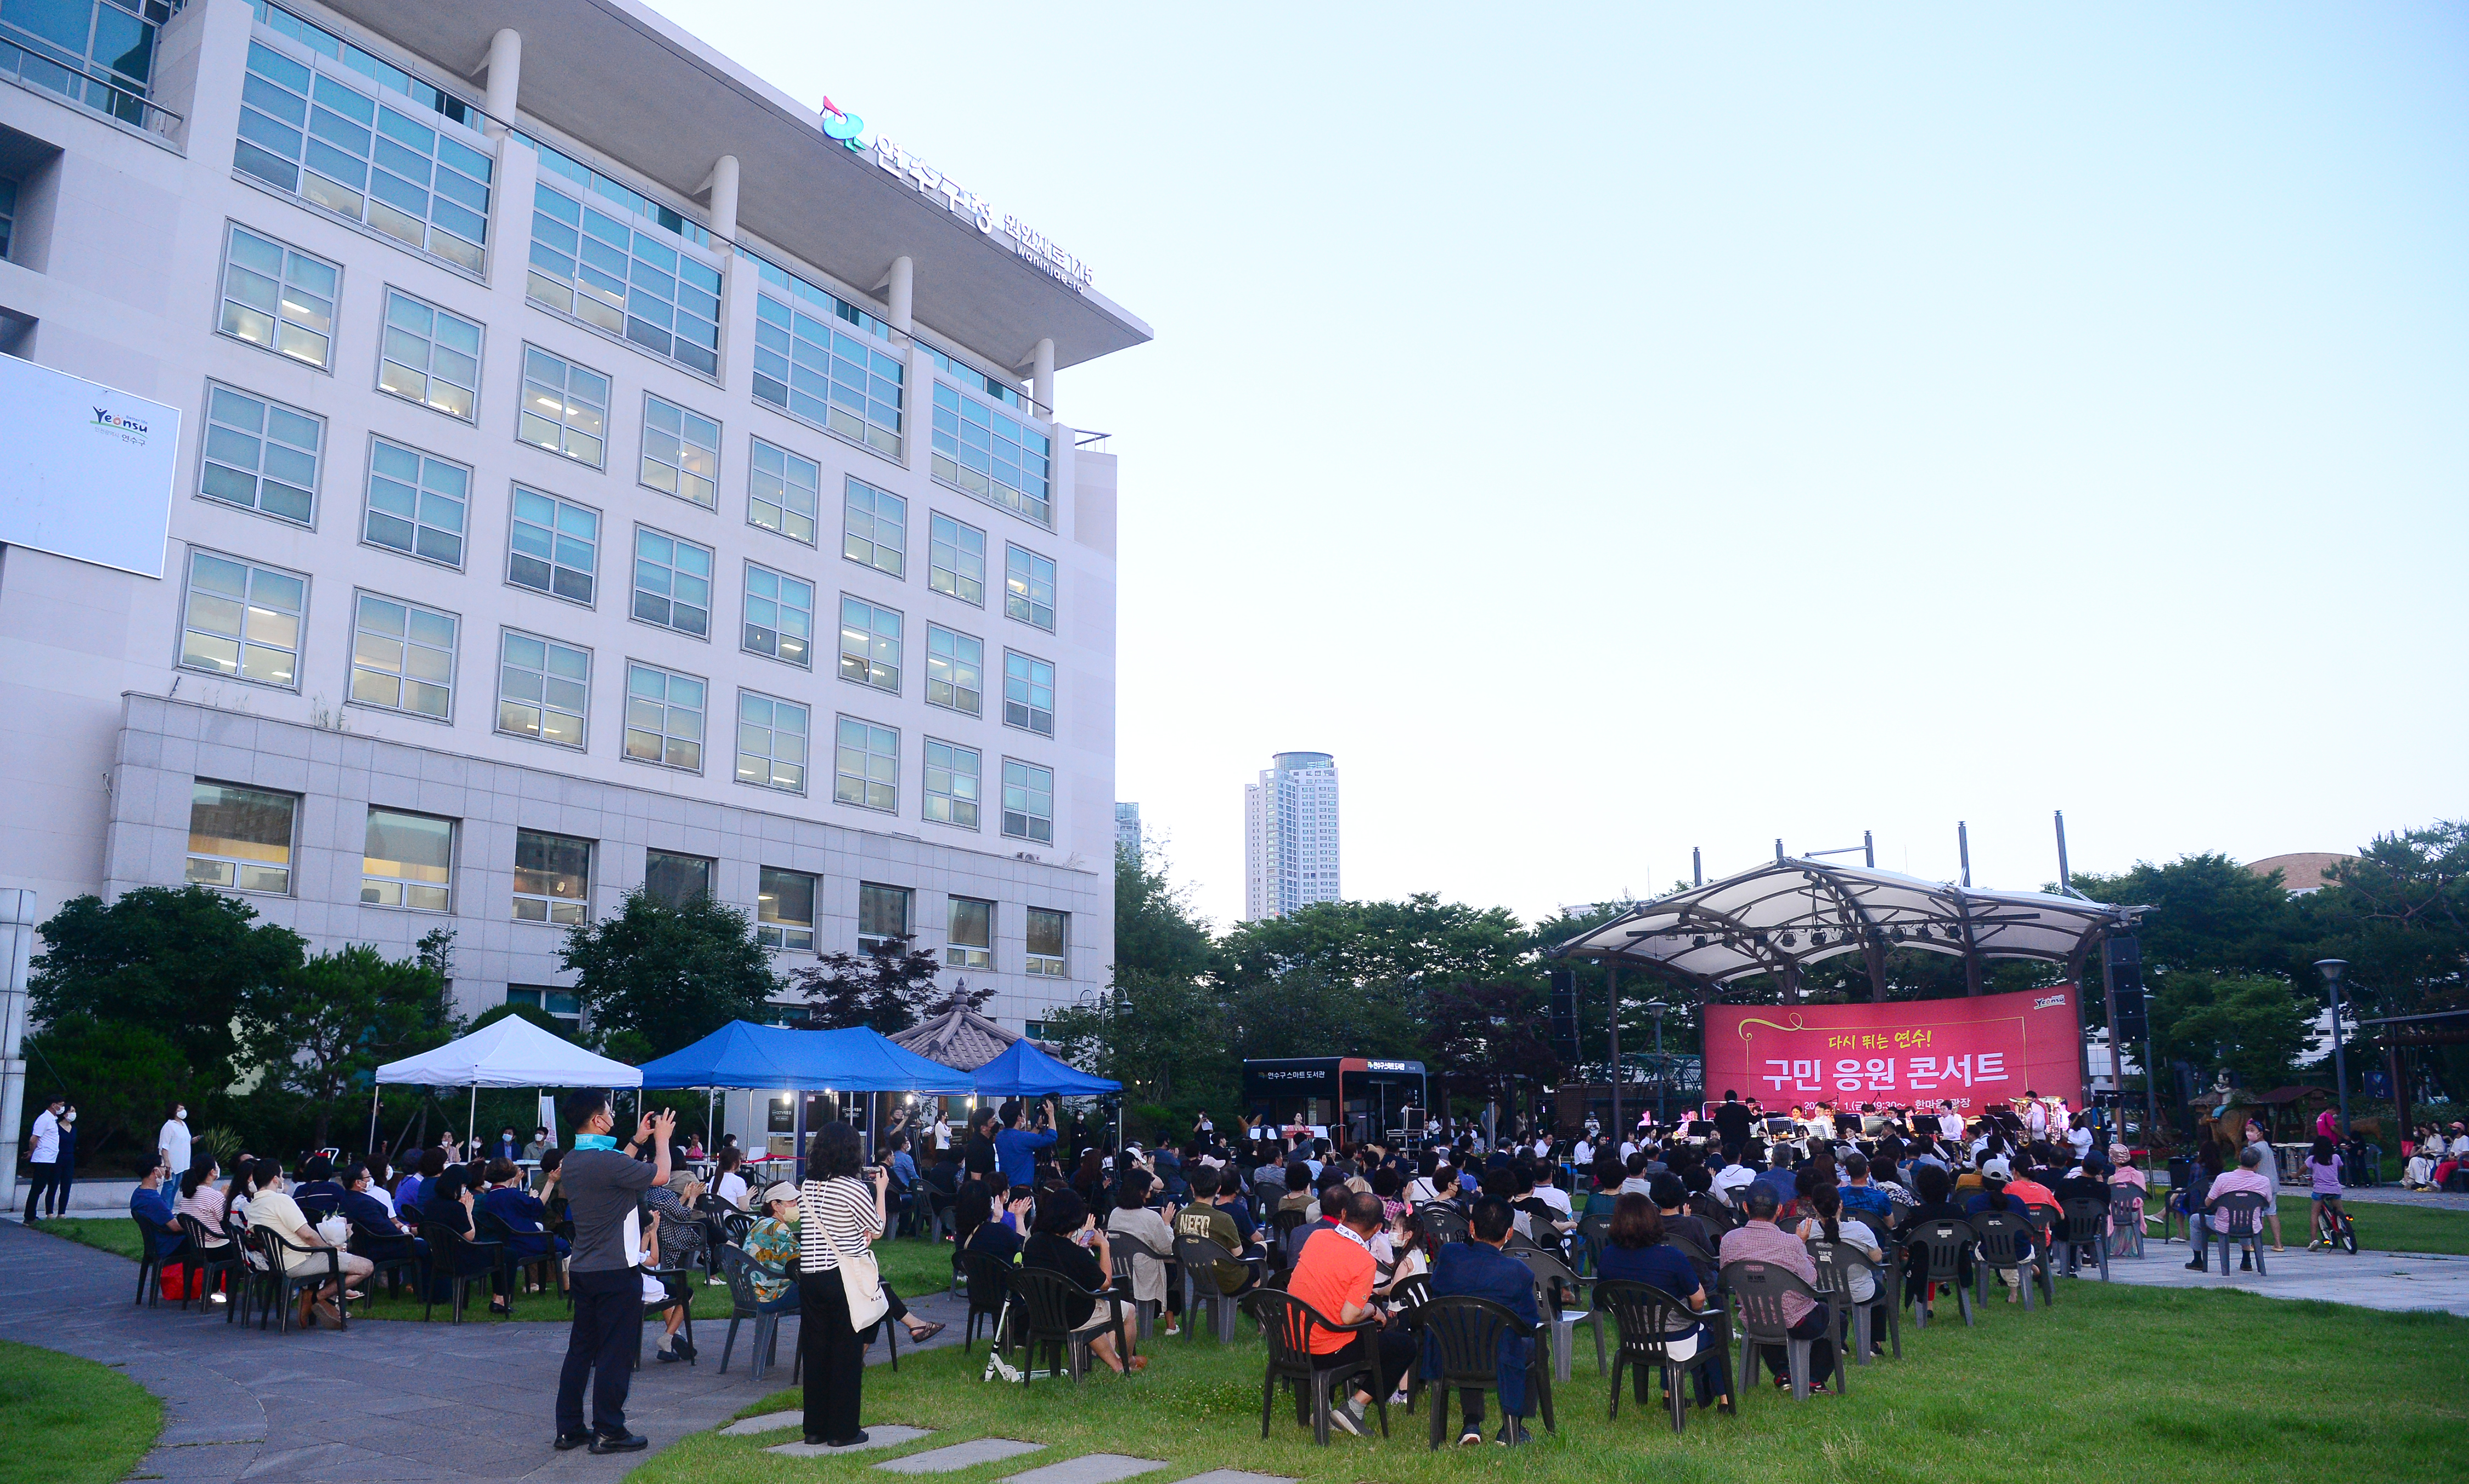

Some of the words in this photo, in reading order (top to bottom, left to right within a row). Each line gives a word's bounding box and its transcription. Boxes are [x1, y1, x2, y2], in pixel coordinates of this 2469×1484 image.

[876, 133, 994, 234] 연수구청
[1004, 212, 1066, 270] 원인재로
[1069, 253, 1095, 286] 115
[1016, 242, 1084, 294] Woninjae-ro
[92, 405, 148, 433] Yeonsu
[122, 434, 146, 447] 연수구
[2035, 997, 2065, 1007] Yeonsu
[1829, 1035, 1856, 1049] 다시
[1862, 1033, 1889, 1049] 뛰는
[1895, 1029, 1932, 1048] 연수!
[1267, 1071, 1286, 1080] 연수구
[1306, 1070, 1326, 1079] 도서관
[1762, 1058, 1822, 1091] 구민
[1832, 1057, 1896, 1091] 응원
[1906, 1052, 2009, 1089] 콘서트
